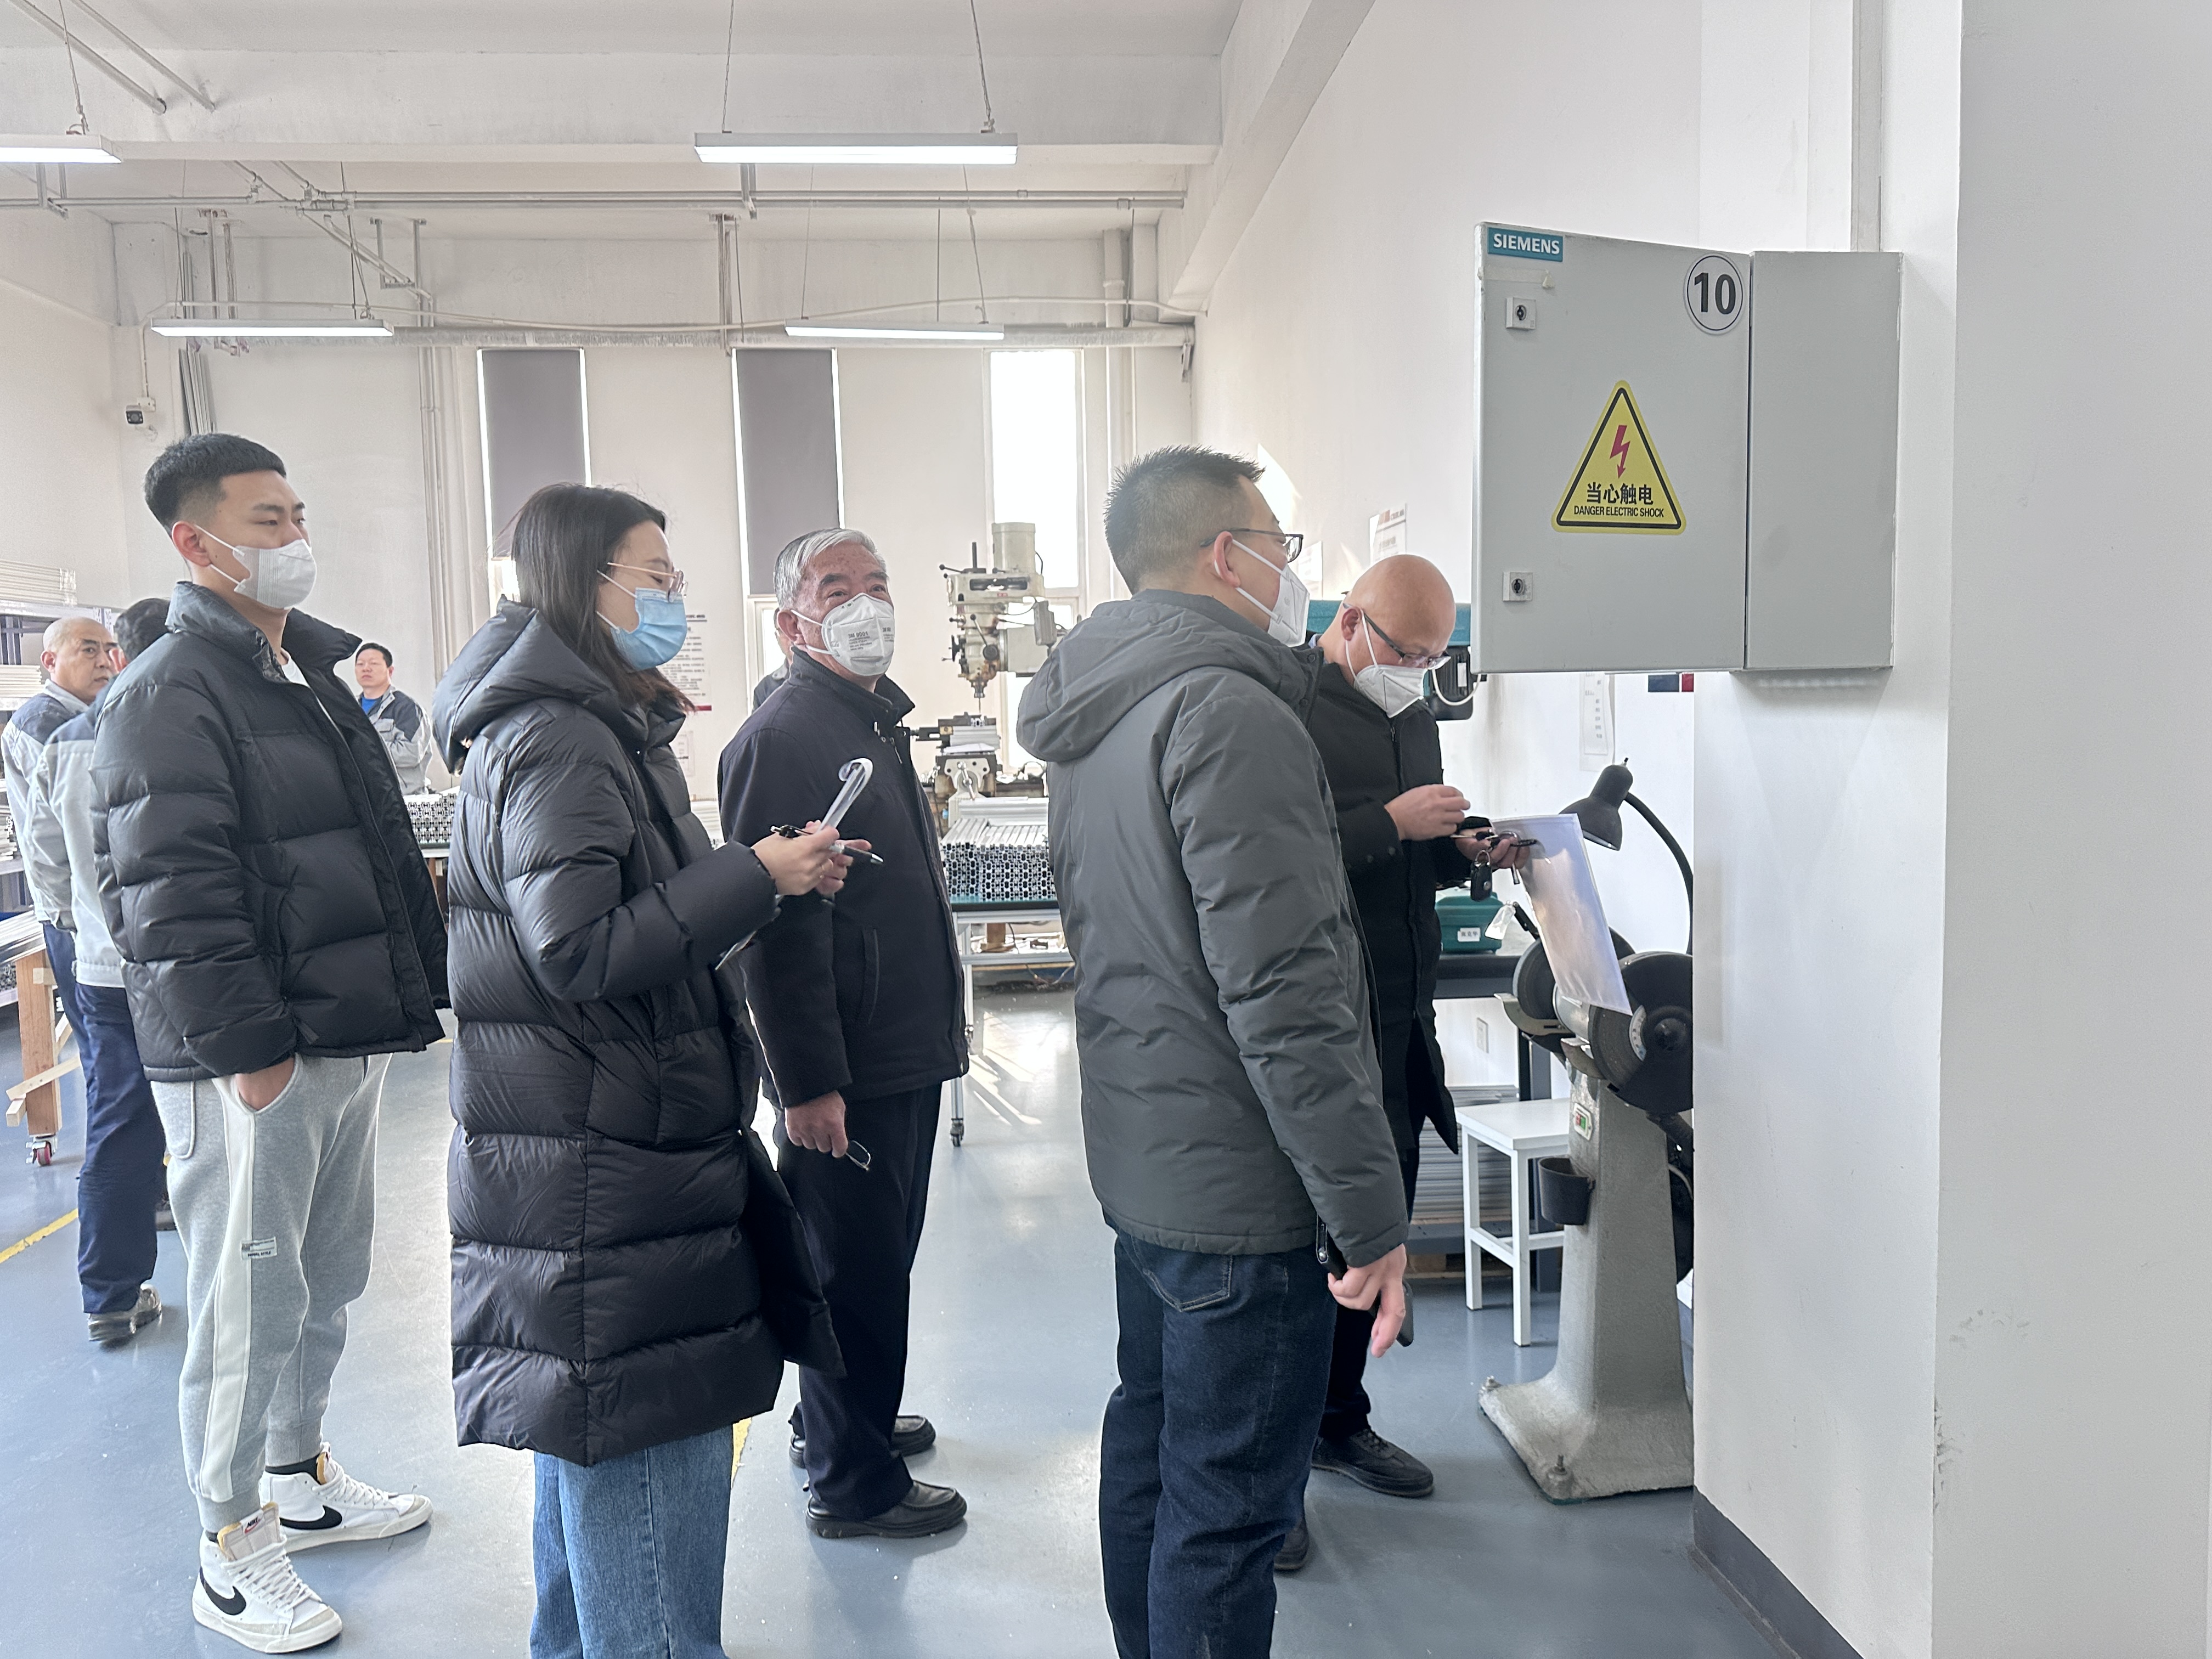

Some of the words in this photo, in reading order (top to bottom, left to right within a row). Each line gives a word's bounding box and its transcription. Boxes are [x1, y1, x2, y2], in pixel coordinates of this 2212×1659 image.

[1493, 233, 1560, 255] SIEMENS
[1694, 272, 1736, 314] 10
[1587, 482, 1654, 505] 当心触电
[1574, 505, 1605, 516] DANGER
[1606, 506, 1638, 517] ELECTRIC
[1640, 507, 1664, 517] SHOCK
